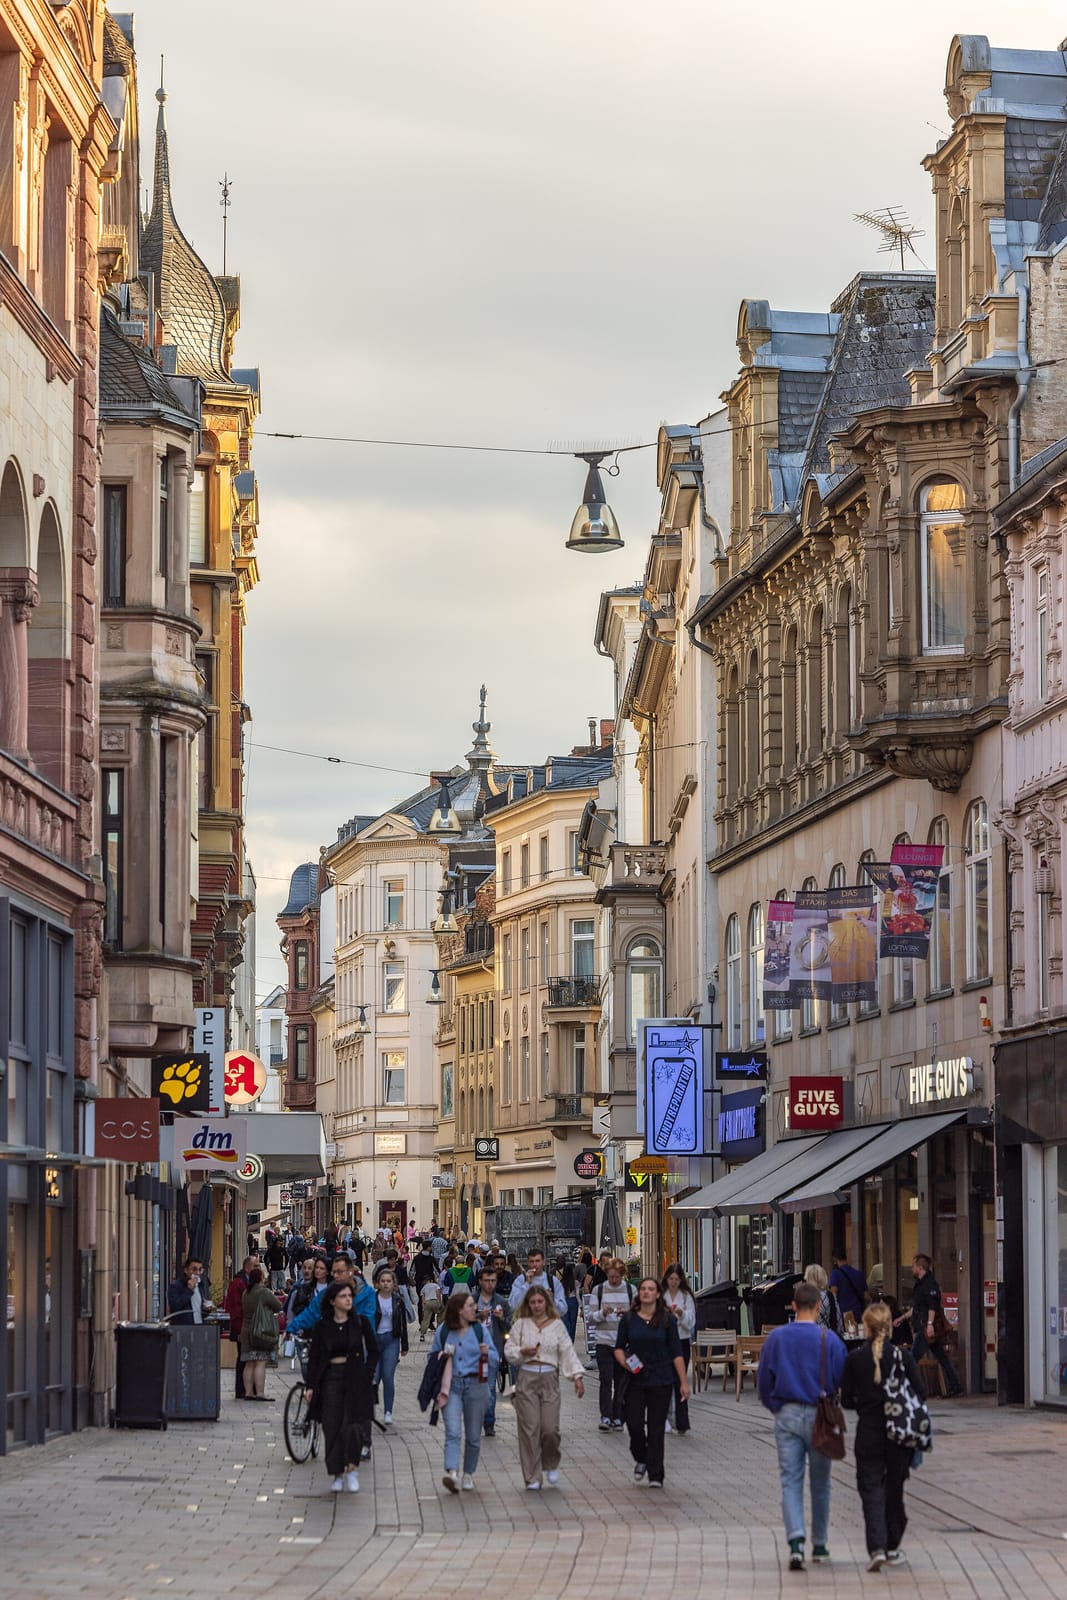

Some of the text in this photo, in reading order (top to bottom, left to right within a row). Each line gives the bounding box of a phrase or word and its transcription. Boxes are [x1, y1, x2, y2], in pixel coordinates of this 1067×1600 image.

[841, 889, 858, 898] DAS
[909, 1056, 970, 1105] FIVE GUYS
[658, 1064, 693, 1147] HANDYREPARATUR
[798, 1090, 835, 1103] FIVE
[793, 1103, 840, 1116] GUYS
[101, 1121, 153, 1140] COS
[192, 1125, 233, 1149] dm
